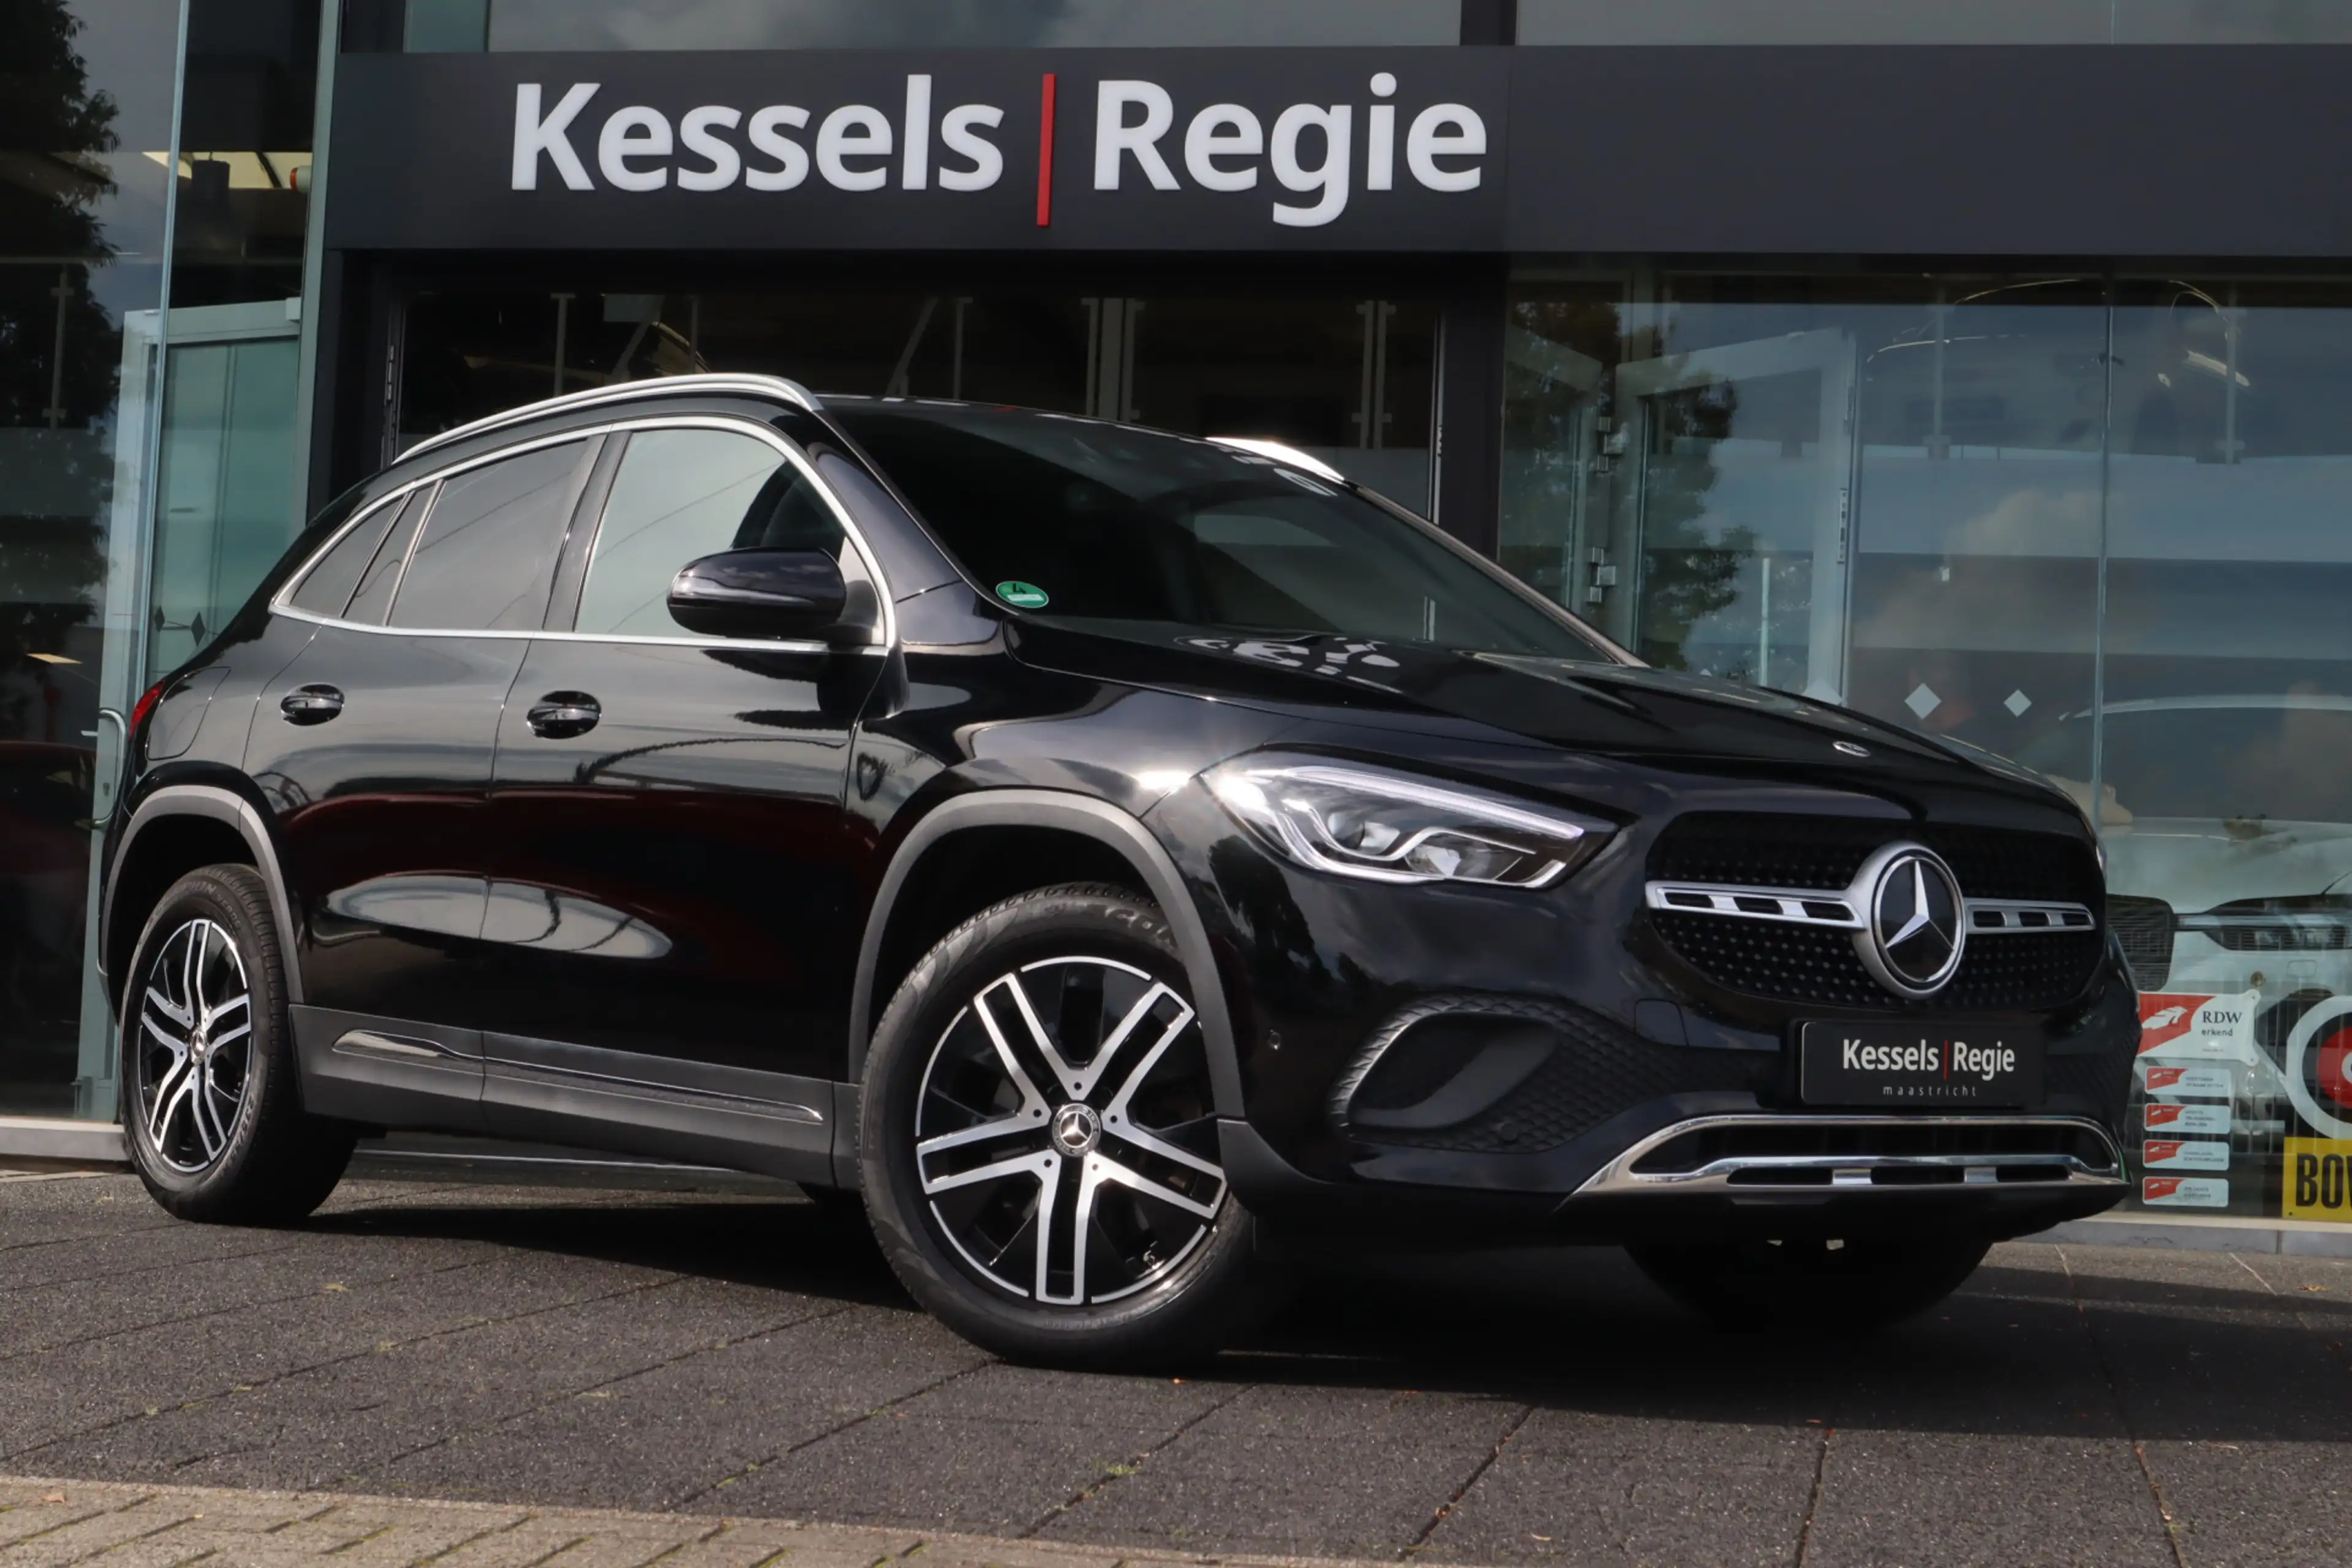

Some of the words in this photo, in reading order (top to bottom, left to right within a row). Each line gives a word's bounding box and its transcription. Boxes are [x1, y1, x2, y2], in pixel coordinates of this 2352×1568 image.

[512, 74, 1005, 192] Kessels
[1094, 72, 1487, 227] Regie
[2202, 1011, 2242, 1023] RDW
[2201, 1027, 2233, 1037] erkend
[1843, 1039, 1939, 1071] Kessels
[1953, 1041, 2015, 1081] Regie
[1883, 1085, 1977, 1096] maastricht
